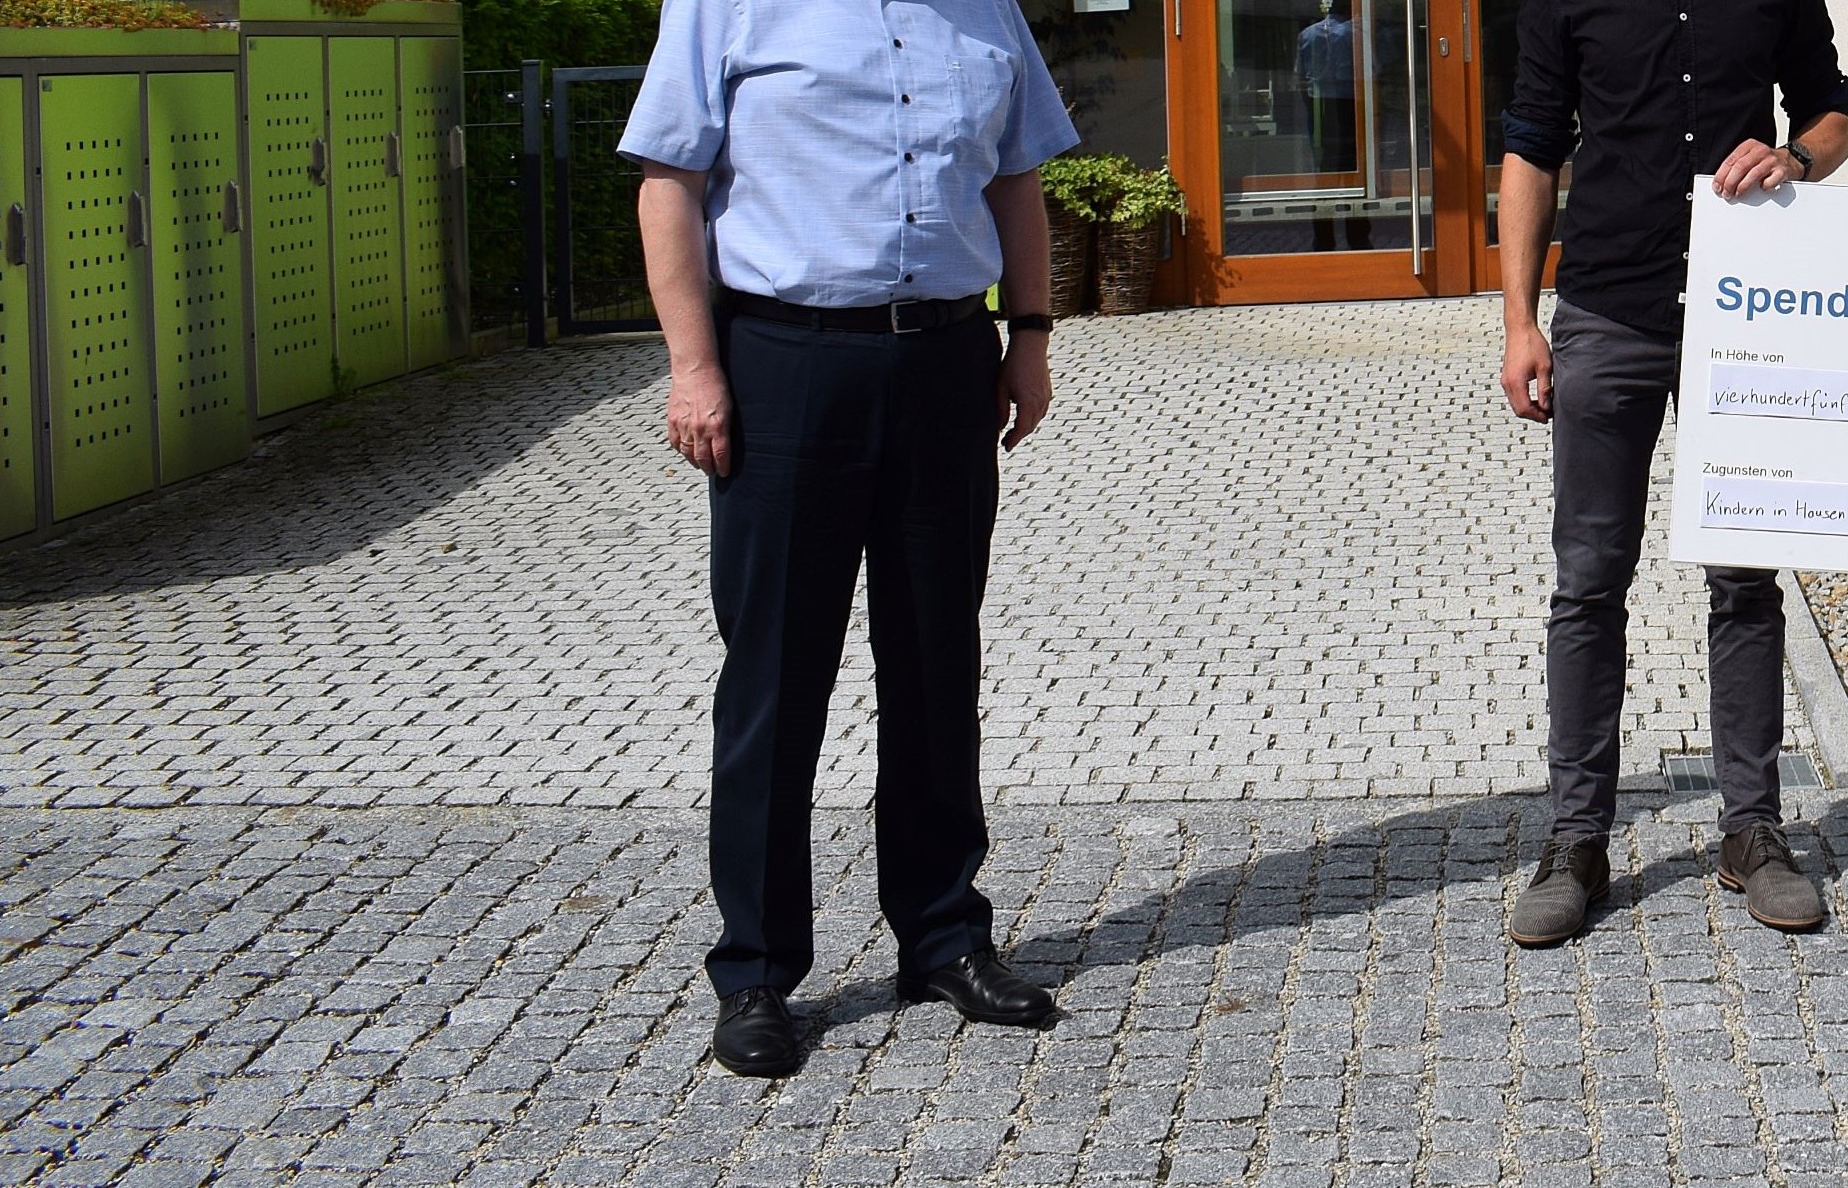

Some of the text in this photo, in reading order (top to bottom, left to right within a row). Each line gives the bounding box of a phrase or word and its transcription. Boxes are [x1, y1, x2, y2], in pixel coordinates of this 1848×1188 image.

[1711, 348, 1784, 363] In Höhe von
[1702, 462, 1793, 479] Zugunsten von
[1705, 491, 1765, 518] Kindern
[1773, 502, 1787, 517] in
[1795, 499, 1846, 520] Hausen
